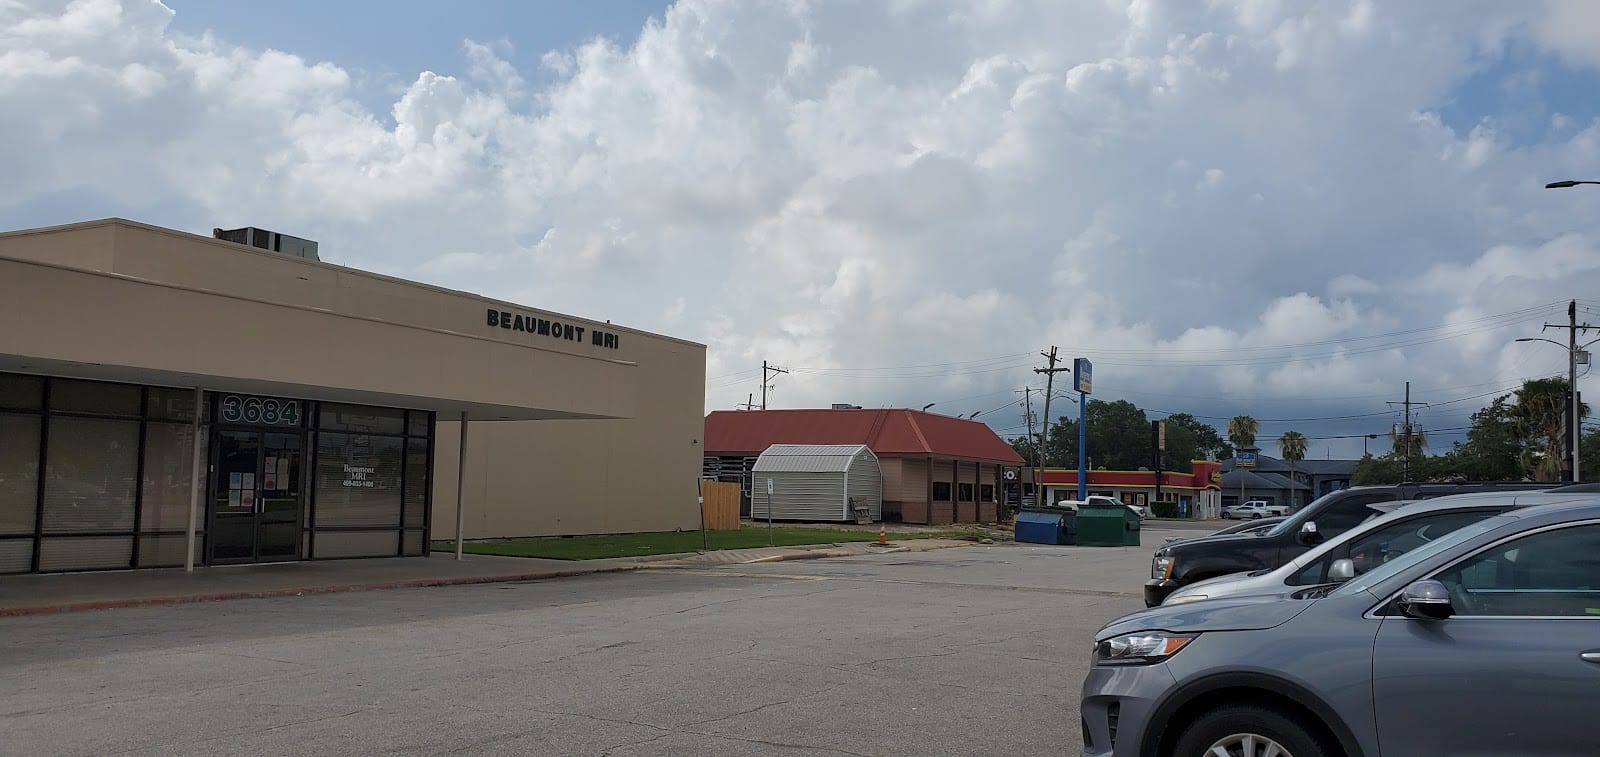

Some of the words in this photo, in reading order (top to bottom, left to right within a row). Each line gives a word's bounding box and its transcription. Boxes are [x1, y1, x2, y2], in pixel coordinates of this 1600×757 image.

[487, 309, 585, 342] BEAUMONT
[592, 330, 619, 349] MRI
[223, 396, 299, 425] 3684
[343, 464, 375, 473] Beaumont
[352, 472, 366, 480] MRI
